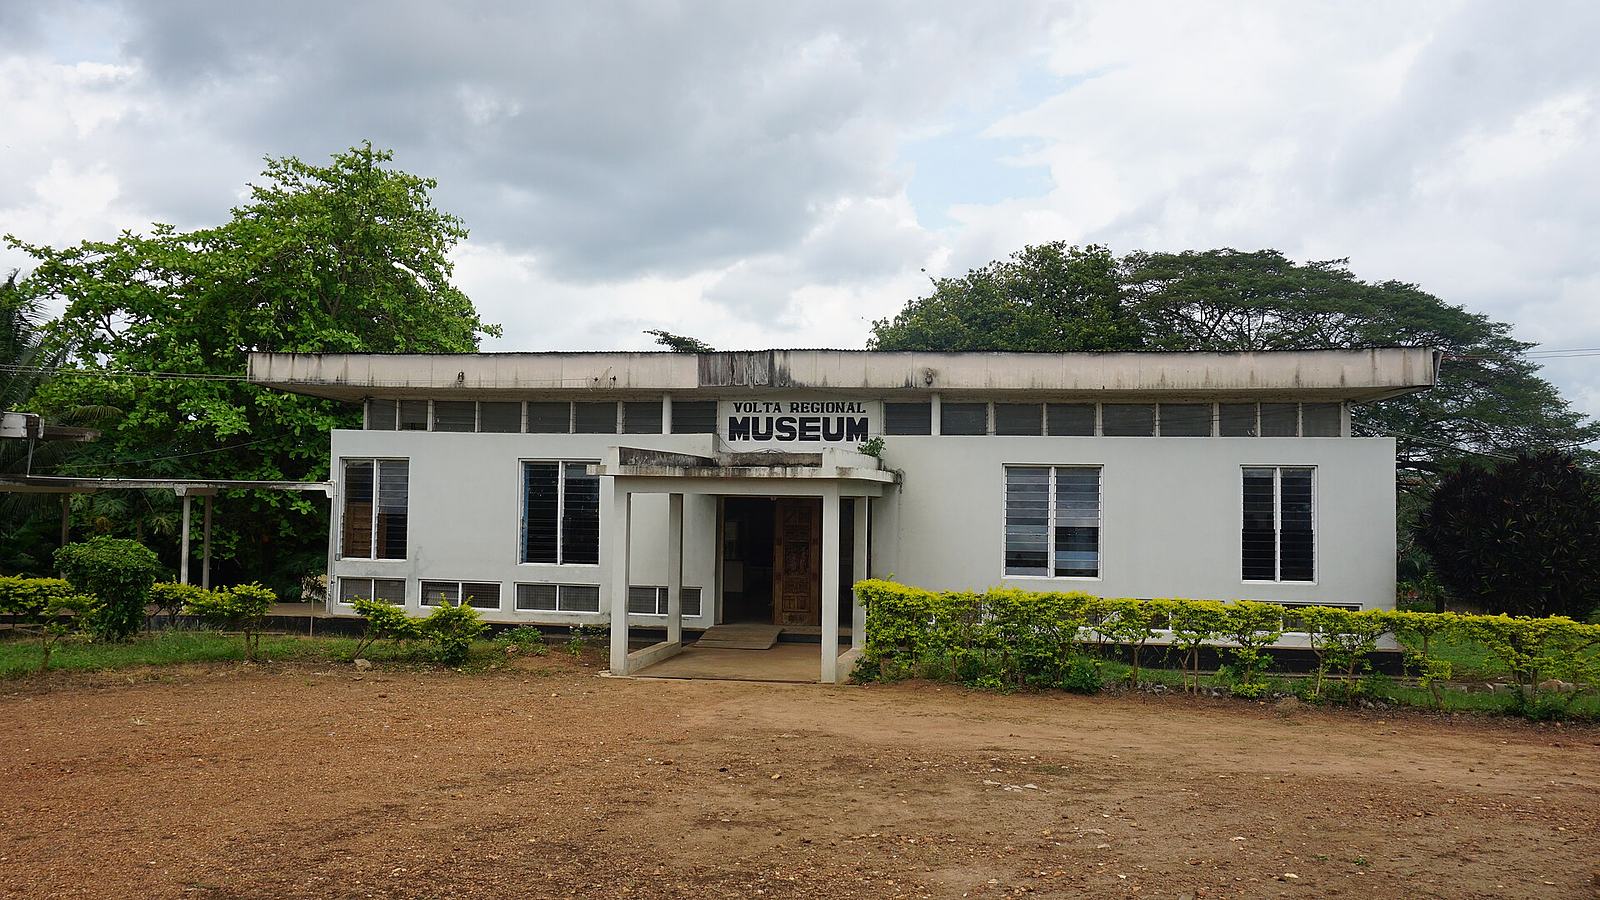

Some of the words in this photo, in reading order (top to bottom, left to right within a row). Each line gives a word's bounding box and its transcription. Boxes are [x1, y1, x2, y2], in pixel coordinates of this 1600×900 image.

[733, 402, 782, 413] VOLTA
[790, 402, 866, 413] REGIONAL
[728, 417, 869, 442] MUSEUM
